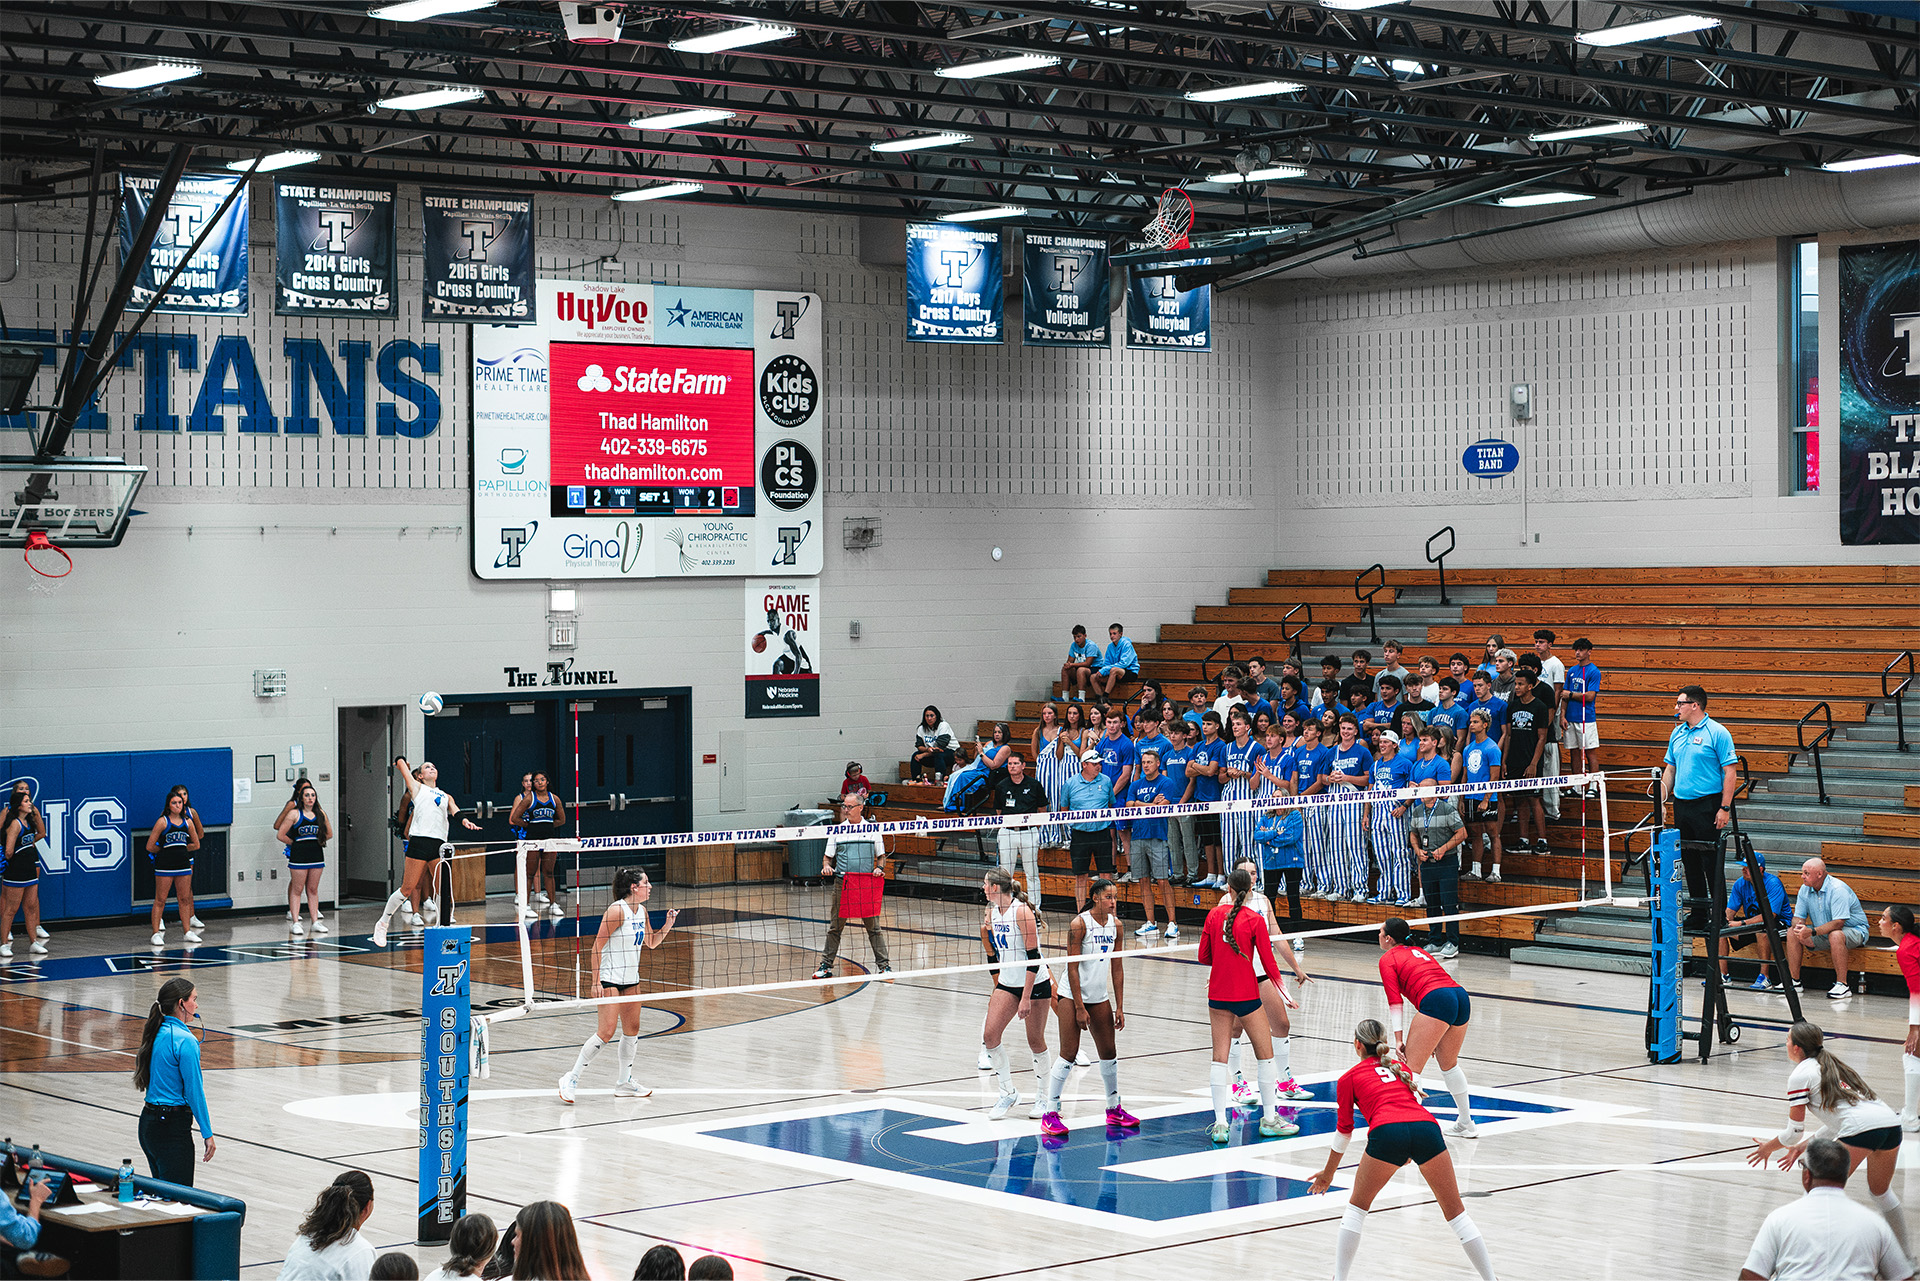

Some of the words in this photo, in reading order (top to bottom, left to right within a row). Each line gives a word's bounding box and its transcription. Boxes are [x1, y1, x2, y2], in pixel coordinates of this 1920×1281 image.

[280, 185, 316, 198] STATE
[320, 187, 391, 202] CHAMPIONS
[425, 197, 458, 208] STATE
[462, 199, 529, 212] CHAMPIONS
[910, 229, 938, 239] STATE
[941, 230, 998, 242] CHAMPIONS
[1026, 235, 1052, 245] STATE
[1055, 237, 1106, 249] CHAMPIONS
[305, 254, 336, 272] 2014
[340, 256, 370, 274] Girls
[449, 263, 478, 279] 2015
[481, 264, 509, 281] Girls
[293, 272, 330, 290] Cross
[334, 274, 382, 295] Country
[437, 281, 472, 297] Cross
[476, 282, 520, 301] Country
[583, 284, 609, 293] Shadow
[283, 287, 389, 310] TITANS
[428, 295, 528, 317] TITANS
[930, 288, 954, 304] 2017
[957, 290, 980, 307] Boys
[1056, 294, 1079, 309] 2019
[691, 311, 743, 321] AMERICAN
[920, 305, 950, 320] Cross
[952, 306, 991, 324] Country
[1158, 301, 1180, 315] 2021
[1046, 310, 1088, 327] Volleyball
[1149, 315, 1190, 332] Volleyball
[912, 318, 997, 337] TITANS
[1028, 321, 1105, 341] TITANS
[1132, 327, 1206, 346] TITANS
[476, 366, 513, 382] PRIME
[518, 367, 547, 382] TIME
[767, 370, 813, 394] Kids
[476, 384, 548, 392] HEALTHCARE
[772, 394, 810, 413] CLUB
[476, 411, 549, 421] PRIMETIMEHEALTHCARE.COM
[599, 412, 637, 430] Thad
[641, 413, 708, 431] Hamilton
[600, 438, 707, 456] 402-339-6675
[1477, 448, 1504, 458] TITAN
[775, 447, 802, 465] PL
[1479, 459, 1502, 470] BAND
[584, 463, 723, 481] thadhamilton.com
[775, 467, 803, 487] CS
[478, 480, 547, 491] PAPILLION
[594, 489, 601, 506] 2
[639, 492, 660, 502] SET
[662, 491, 671, 503] 1
[707, 490, 715, 506] 2
[770, 491, 809, 499] Foundation
[703, 522, 734, 531] YOUNG
[687, 533, 748, 541] CHIROPRACTIC
[565, 560, 592, 568] Physical
[594, 560, 620, 568] Therapy
[764, 594, 810, 613] GAME
[786, 613, 808, 631] ON
[556, 629, 570, 642] EXIT
[1435, 783, 1475, 794] PAPILLION
[1477, 783, 1487, 791] LA
[1490, 781, 1512, 790] VISTA
[1514, 779, 1538, 788] SOUTH
[1541, 777, 1568, 786] TITANS
[1251, 796, 1295, 808] PAPILLION
[1298, 796, 1308, 804] LA
[1311, 794, 1336, 803] VISTA
[1338, 792, 1364, 802] SOUTH
[1367, 790, 1397, 800] TITANS
[1049, 811, 1097, 822] PAPILLION
[1100, 810, 1112, 818] LA
[1115, 807, 1142, 817] VISTA
[1145, 805, 1174, 815] SOUTH
[1177, 803, 1209, 813] TITANS
[299, 825, 318, 835] SOUT
[826, 824, 880, 835] PAPILLION
[883, 823, 895, 832] LA
[899, 821, 929, 830] VISTA
[932, 818, 964, 828] SOUTH
[968, 816, 1003, 826] TITANS
[581, 837, 639, 848] PAPILLION
[643, 837, 656, 846] LA
[661, 835, 693, 845] VISTA
[697, 832, 733, 842] SOUTH
[737, 829, 776, 840] TITANS
[633, 931, 645, 946] 10
[996, 934, 1009, 949] 14
[1094, 935, 1114, 944] TITANS
[1411, 949, 1431, 962] 4
[1374, 1066, 1397, 1083] 9
[437, 1007, 457, 1223] SOUTHSIDE
